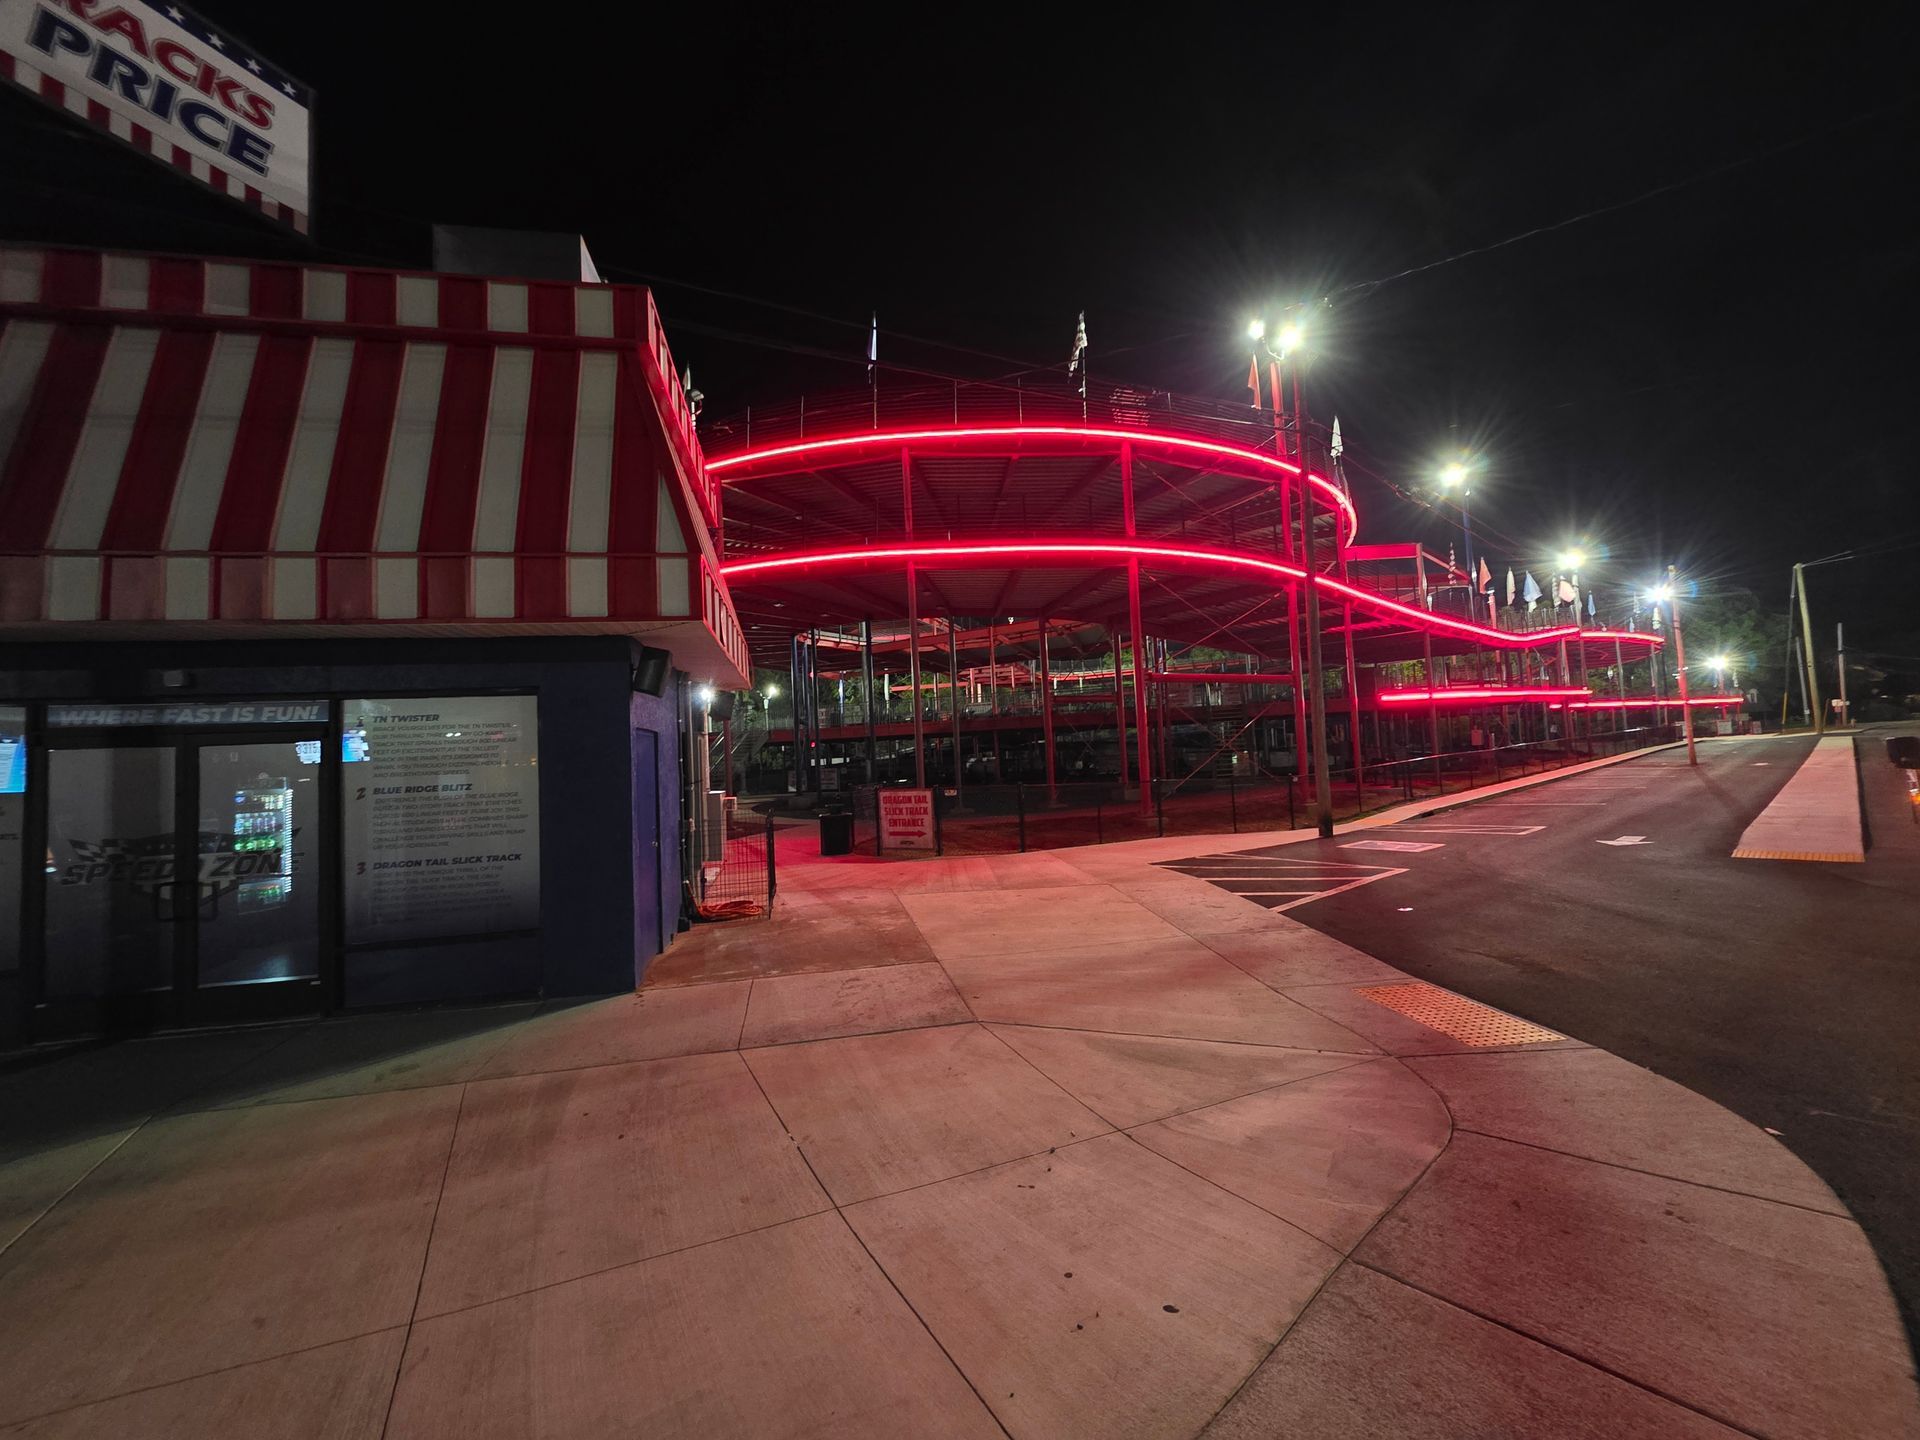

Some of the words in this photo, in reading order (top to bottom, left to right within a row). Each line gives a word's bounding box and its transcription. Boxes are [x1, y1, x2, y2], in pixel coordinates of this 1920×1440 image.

[55, 0, 275, 130] RACKS
[26, 4, 275, 177] PRICE
[60, 709, 153, 726] WHERE
[160, 707, 226, 724] FAST
[231, 706, 255, 723] IS
[260, 705, 319, 721] FUN!
[373, 715, 388, 723] TN
[389, 714, 440, 723] TWISTER
[356, 787, 366, 800] 2
[373, 786, 403, 795] BLUE
[404, 785, 440, 793] RIDGE
[441, 783, 472, 792] BLITZ
[882, 795, 913, 804] DRAGON
[913, 795, 928, 804] TAIL
[884, 807, 903, 816] SLICK
[905, 806, 928, 815] TRACK
[888, 818, 924, 827] ENTRANCE
[356, 862, 367, 875] 3
[373, 859, 422, 870] DRAGON
[425, 857, 449, 867] TAIL
[452, 855, 484, 865] SLICK
[486, 853, 522, 863] TRACK
